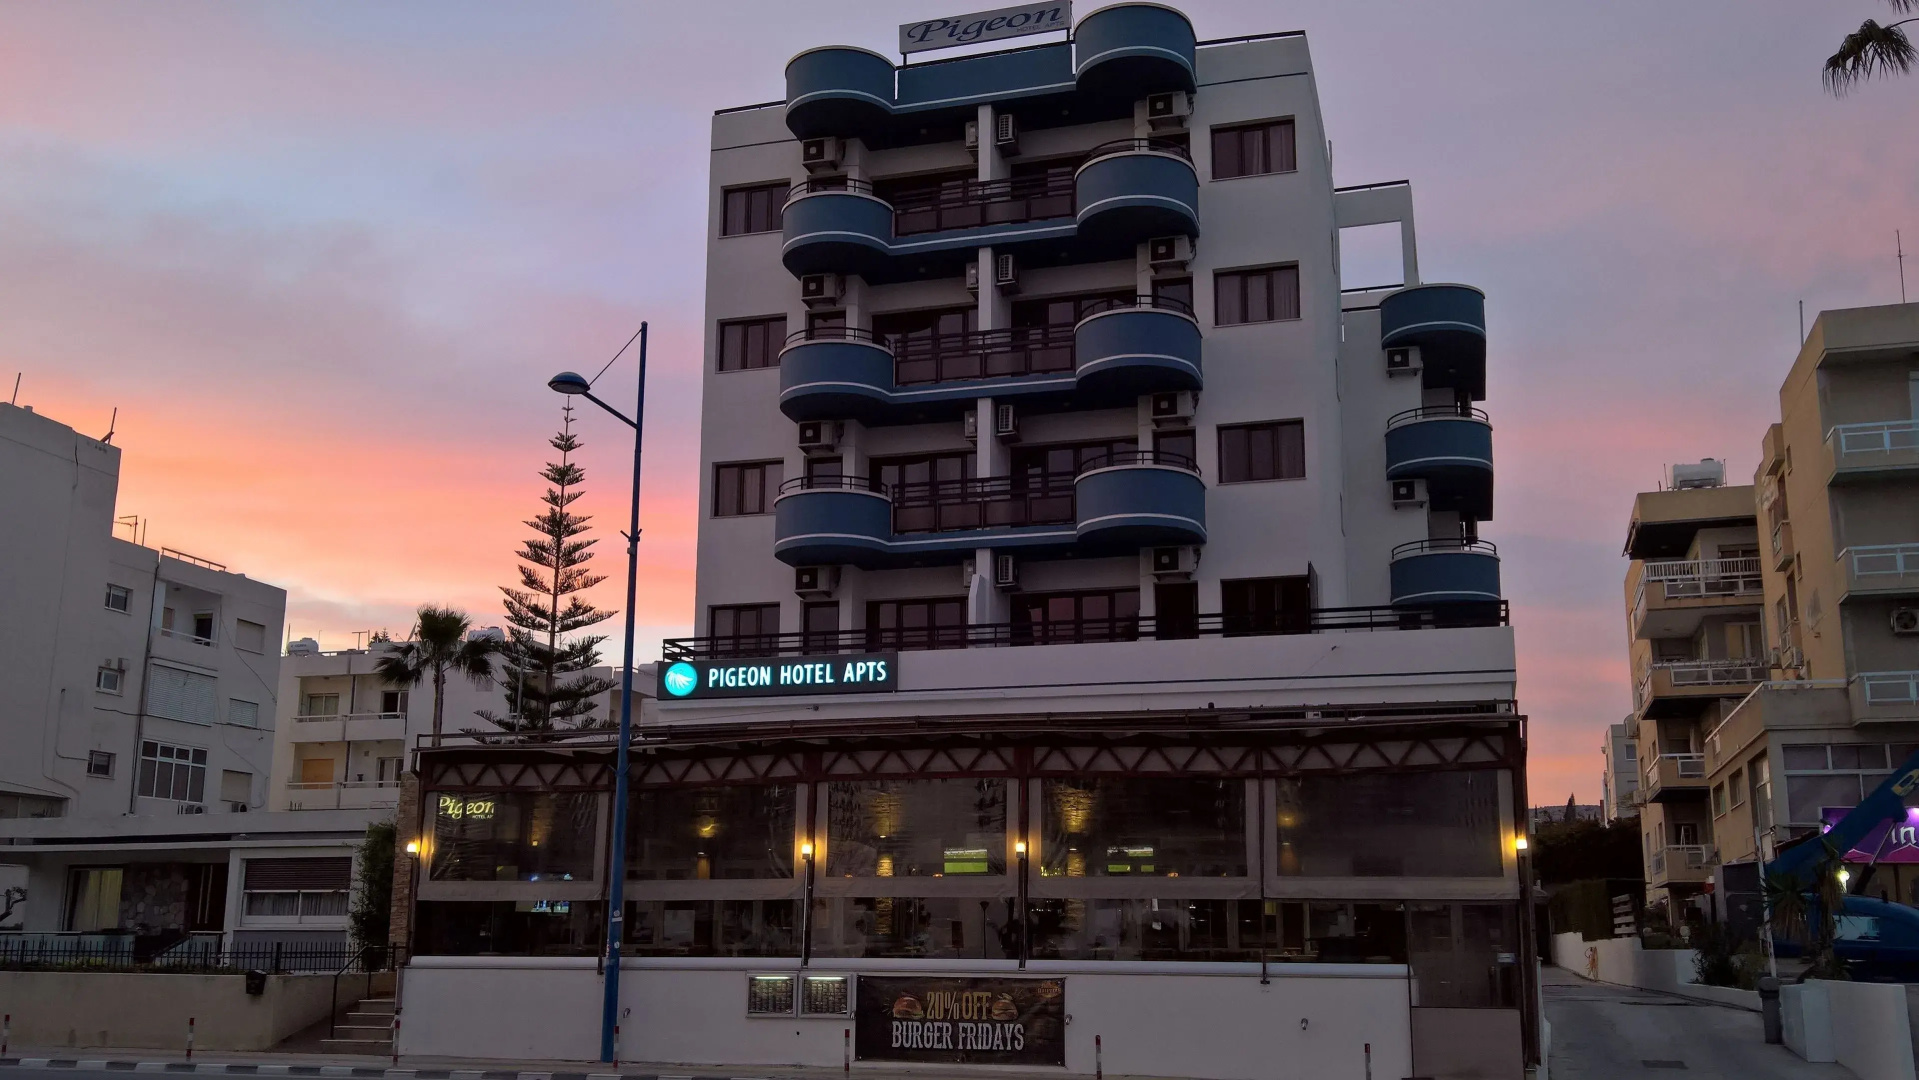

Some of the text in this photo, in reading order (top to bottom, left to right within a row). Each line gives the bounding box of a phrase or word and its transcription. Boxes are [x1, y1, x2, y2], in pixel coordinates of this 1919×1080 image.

[907, 8, 1064, 43] Pigeon
[708, 661, 887, 688] PIGEON HOTEL APTS
[439, 796, 495, 819] Pigeon
[926, 991, 992, 1020] 20% OFF
[892, 1021, 1025, 1051] BURGER FRIDAYS
